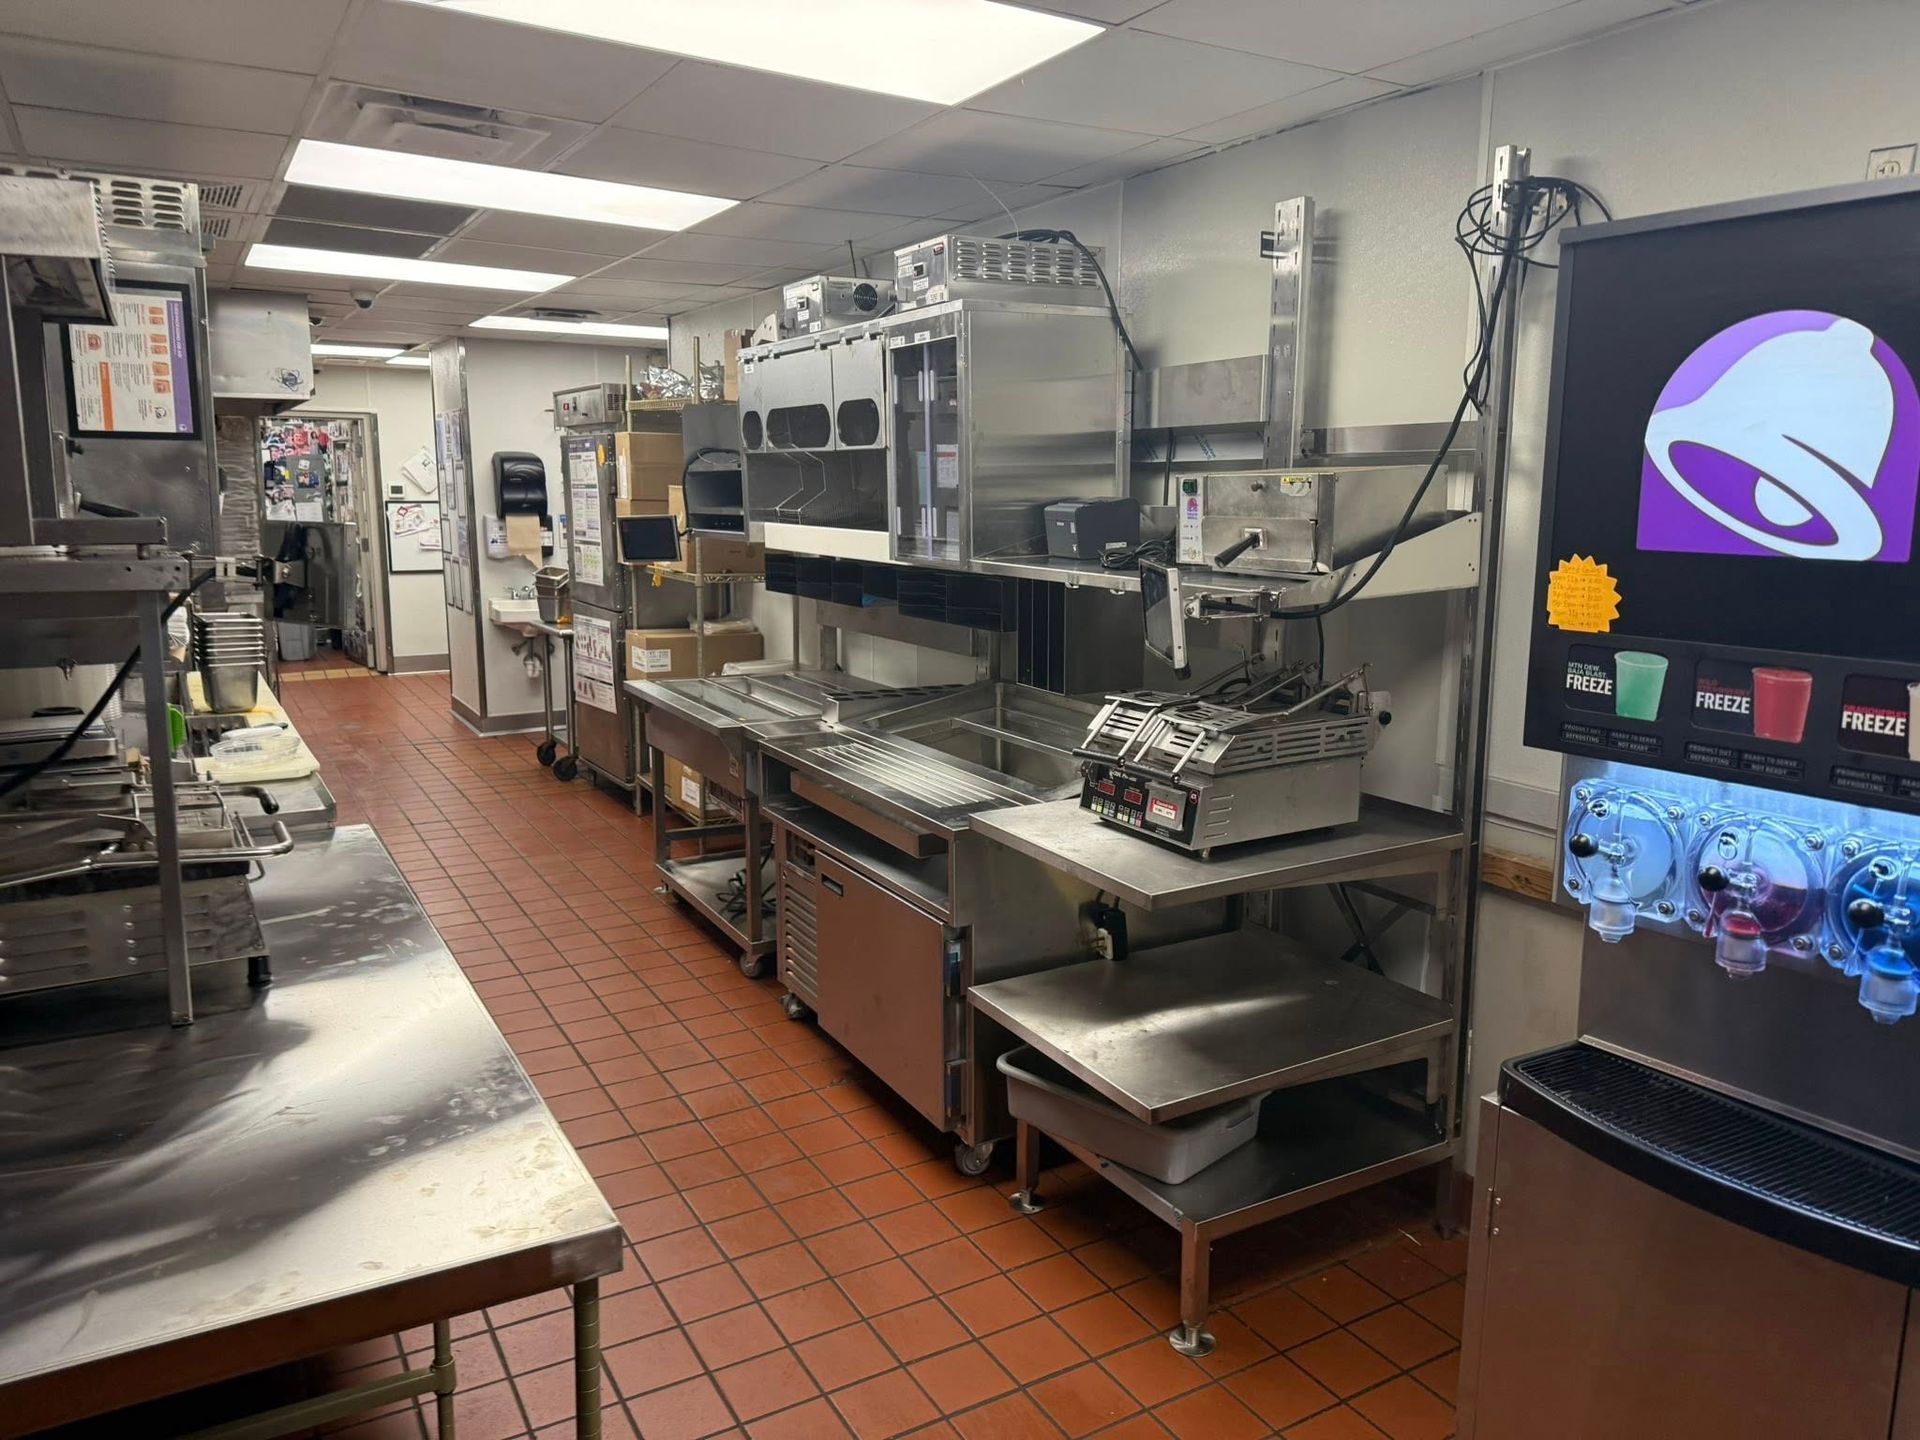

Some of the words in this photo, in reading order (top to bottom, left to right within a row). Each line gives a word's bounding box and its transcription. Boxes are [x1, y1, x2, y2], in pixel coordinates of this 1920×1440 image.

[1567, 661, 1583, 669] MTN
[1567, 667, 1585, 675] BAJA
[1585, 670, 1607, 679] BLAST
[1566, 673, 1613, 695] FREEZE
[1695, 690, 1751, 714] FREEZE
[1841, 710, 1907, 737] FREEZE
[1688, 743, 1718, 755] PRODUCT
[1690, 753, 1730, 766] DEFROSTING
